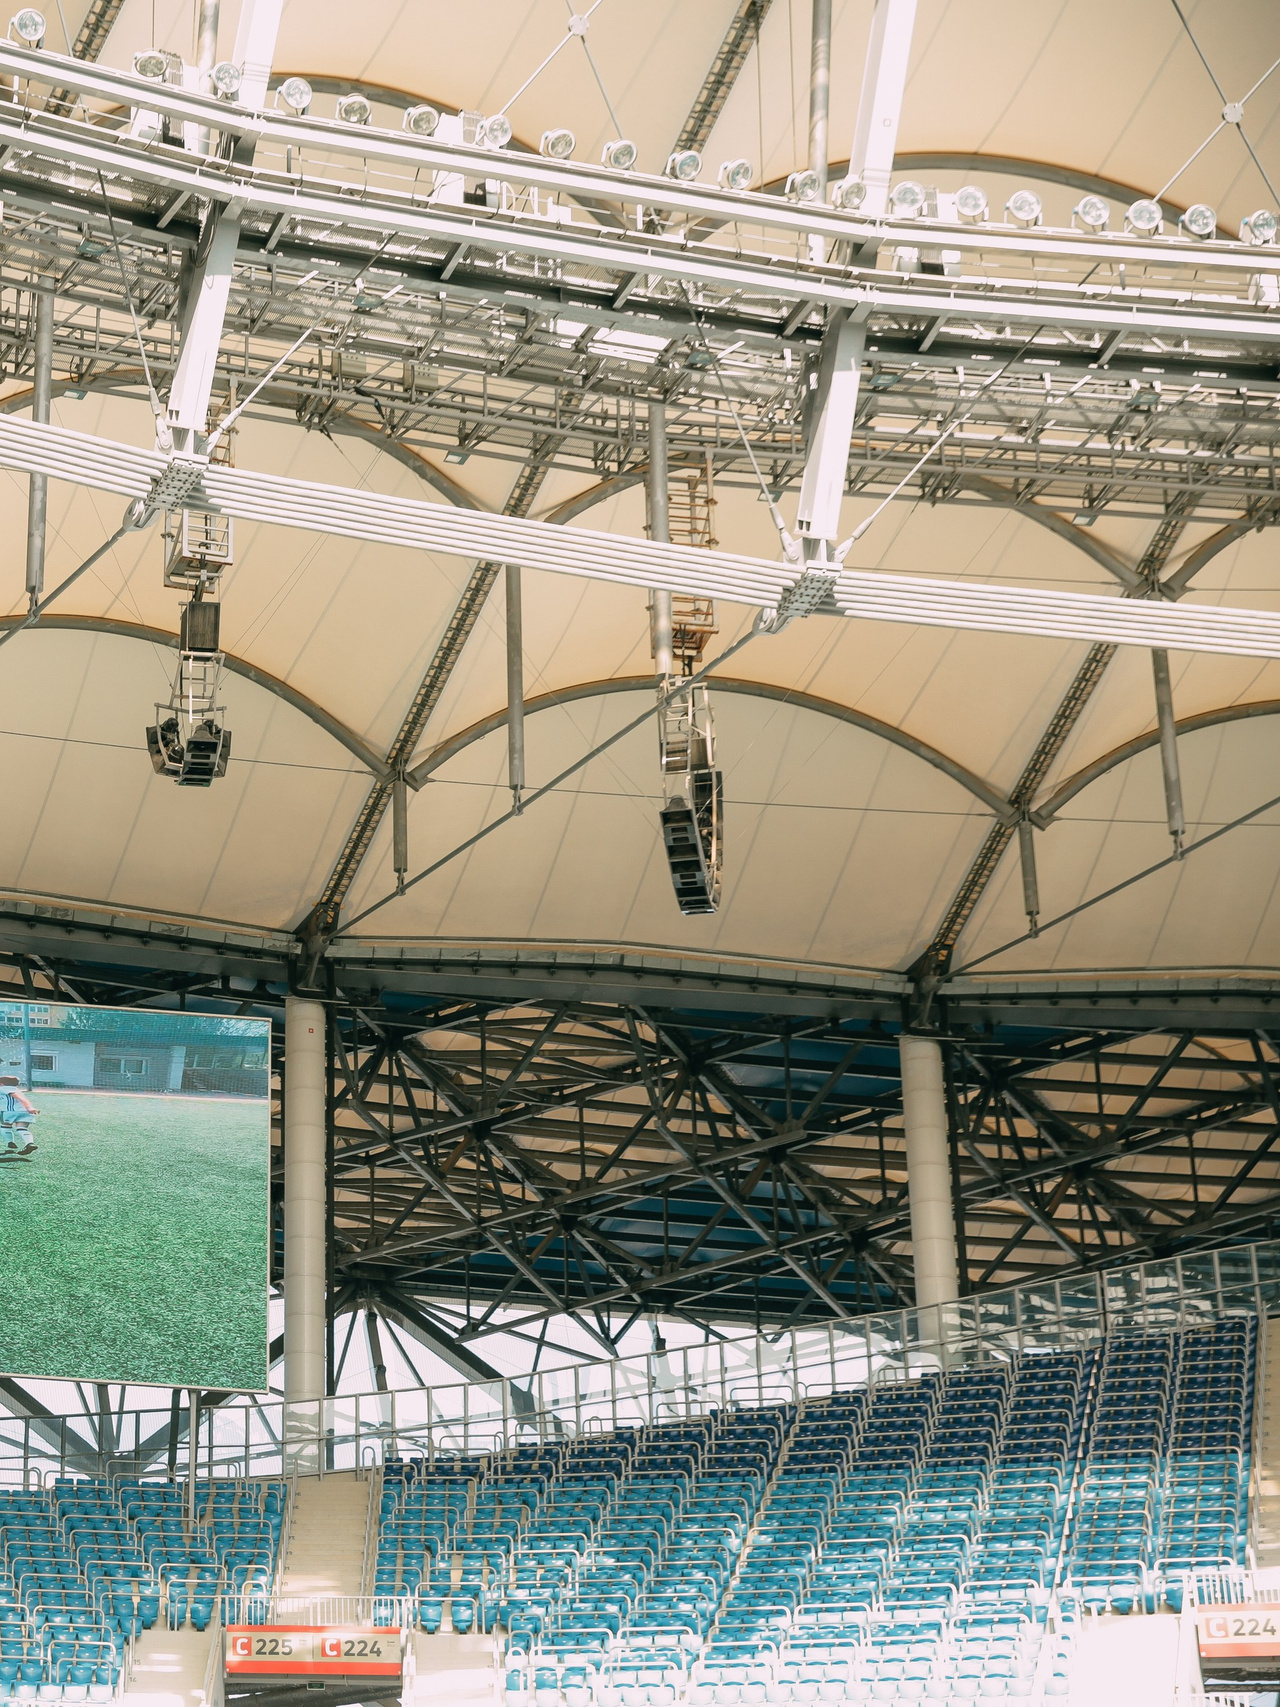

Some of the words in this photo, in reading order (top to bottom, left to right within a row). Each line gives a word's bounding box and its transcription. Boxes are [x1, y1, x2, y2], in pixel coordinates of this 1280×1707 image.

[1209, 1618, 1226, 1637] C
[1233, 1618, 1276, 1636] 224
[236, 1638, 249, 1655] C
[255, 1638, 293, 1656] 225
[324, 1638, 338, 1656] C
[343, 1640, 382, 1657] 224
